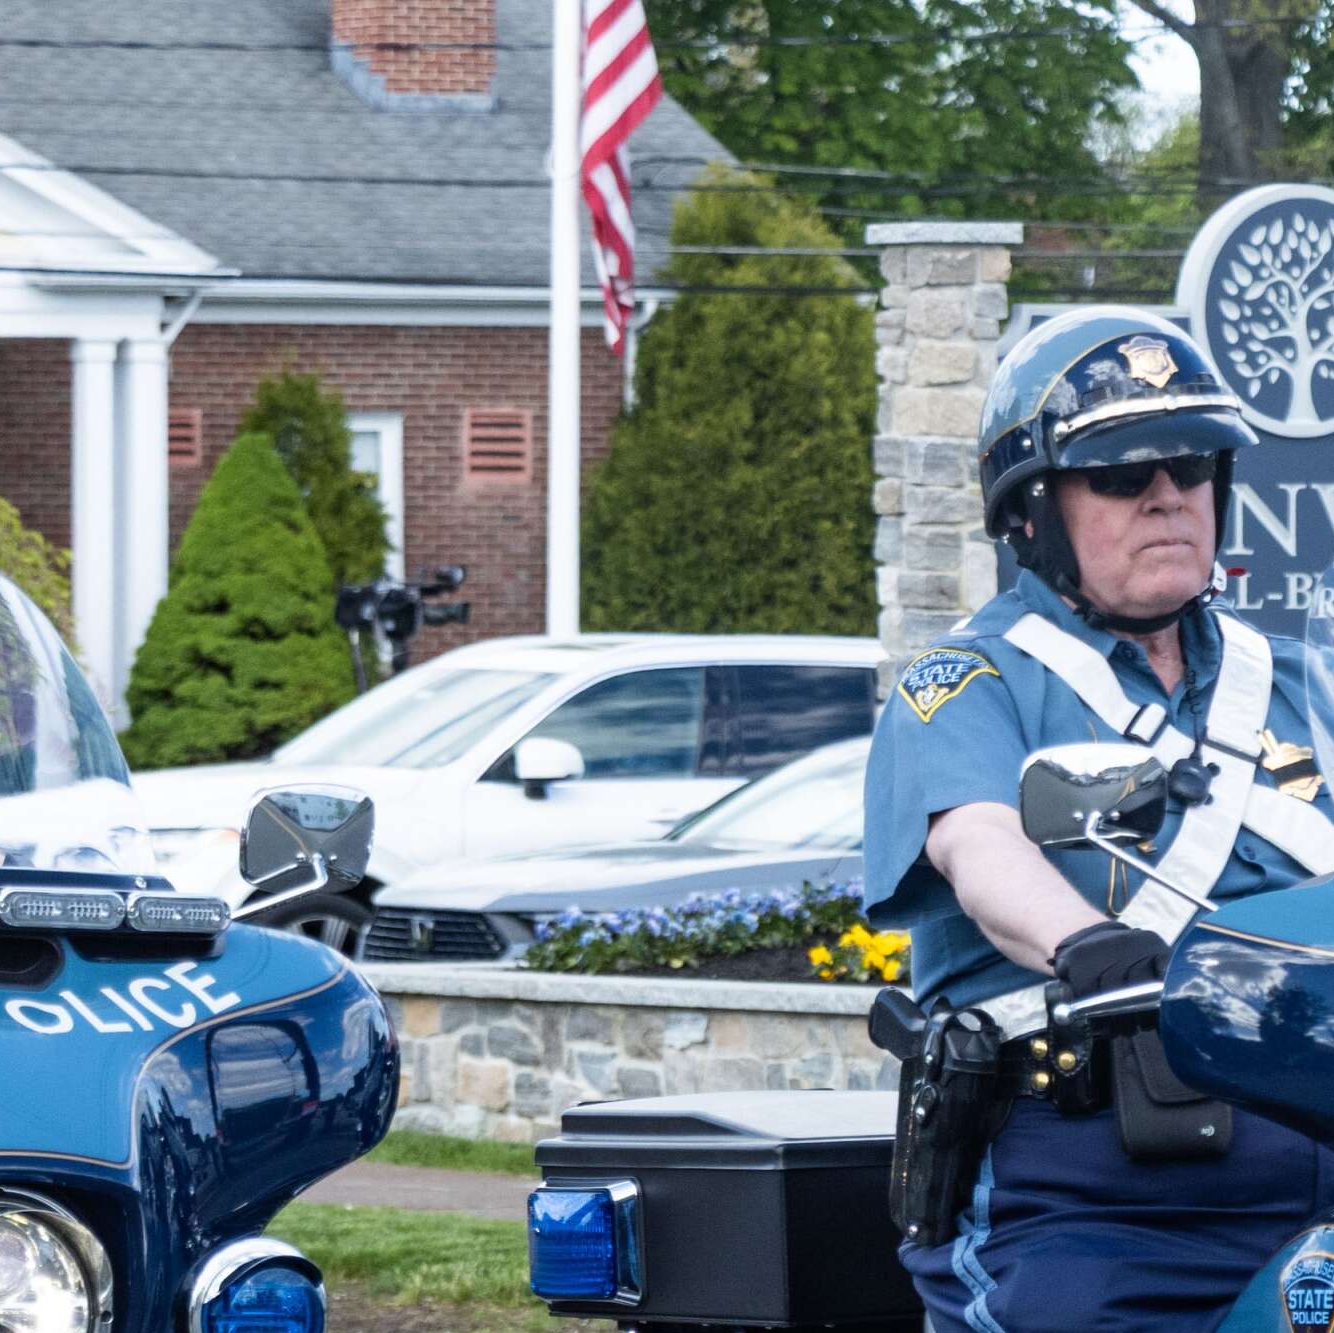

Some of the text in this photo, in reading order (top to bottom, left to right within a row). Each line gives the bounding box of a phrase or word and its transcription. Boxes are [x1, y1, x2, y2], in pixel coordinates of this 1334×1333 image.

[908, 662, 969, 684] STATE
[908, 672, 961, 692] POLICE
[1288, 1289, 1334, 1310] STATE
[1292, 1311, 1330, 1325] POLICE
